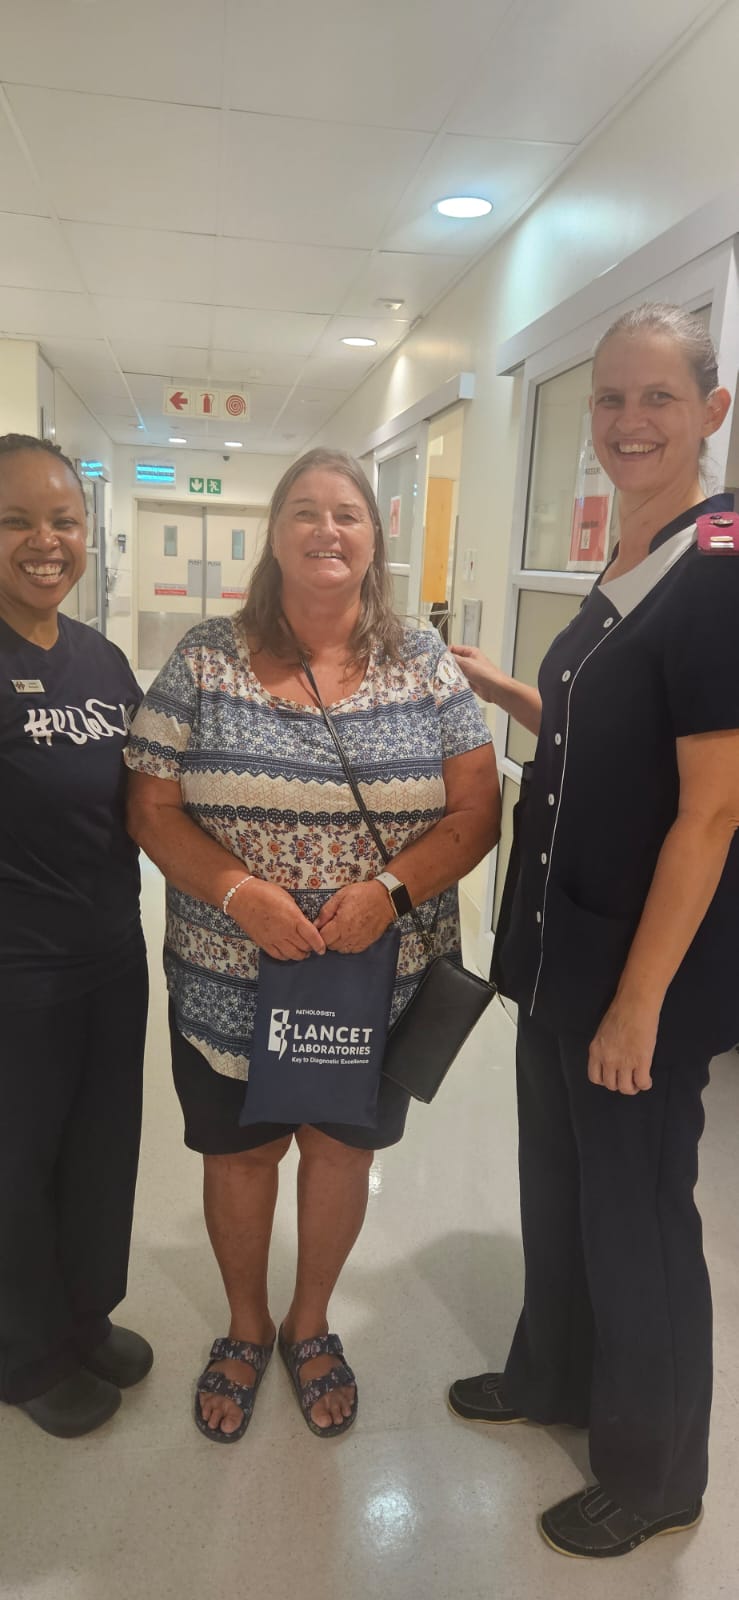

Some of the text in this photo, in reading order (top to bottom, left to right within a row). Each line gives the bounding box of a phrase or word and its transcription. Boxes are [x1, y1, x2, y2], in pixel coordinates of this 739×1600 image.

[295, 1009, 336, 1017] PATHOLOGISTS
[293, 1023, 373, 1044] LANCET
[292, 1043, 371, 1056] LABORATORIES
[310, 1057, 339, 1065] Diagnostic
